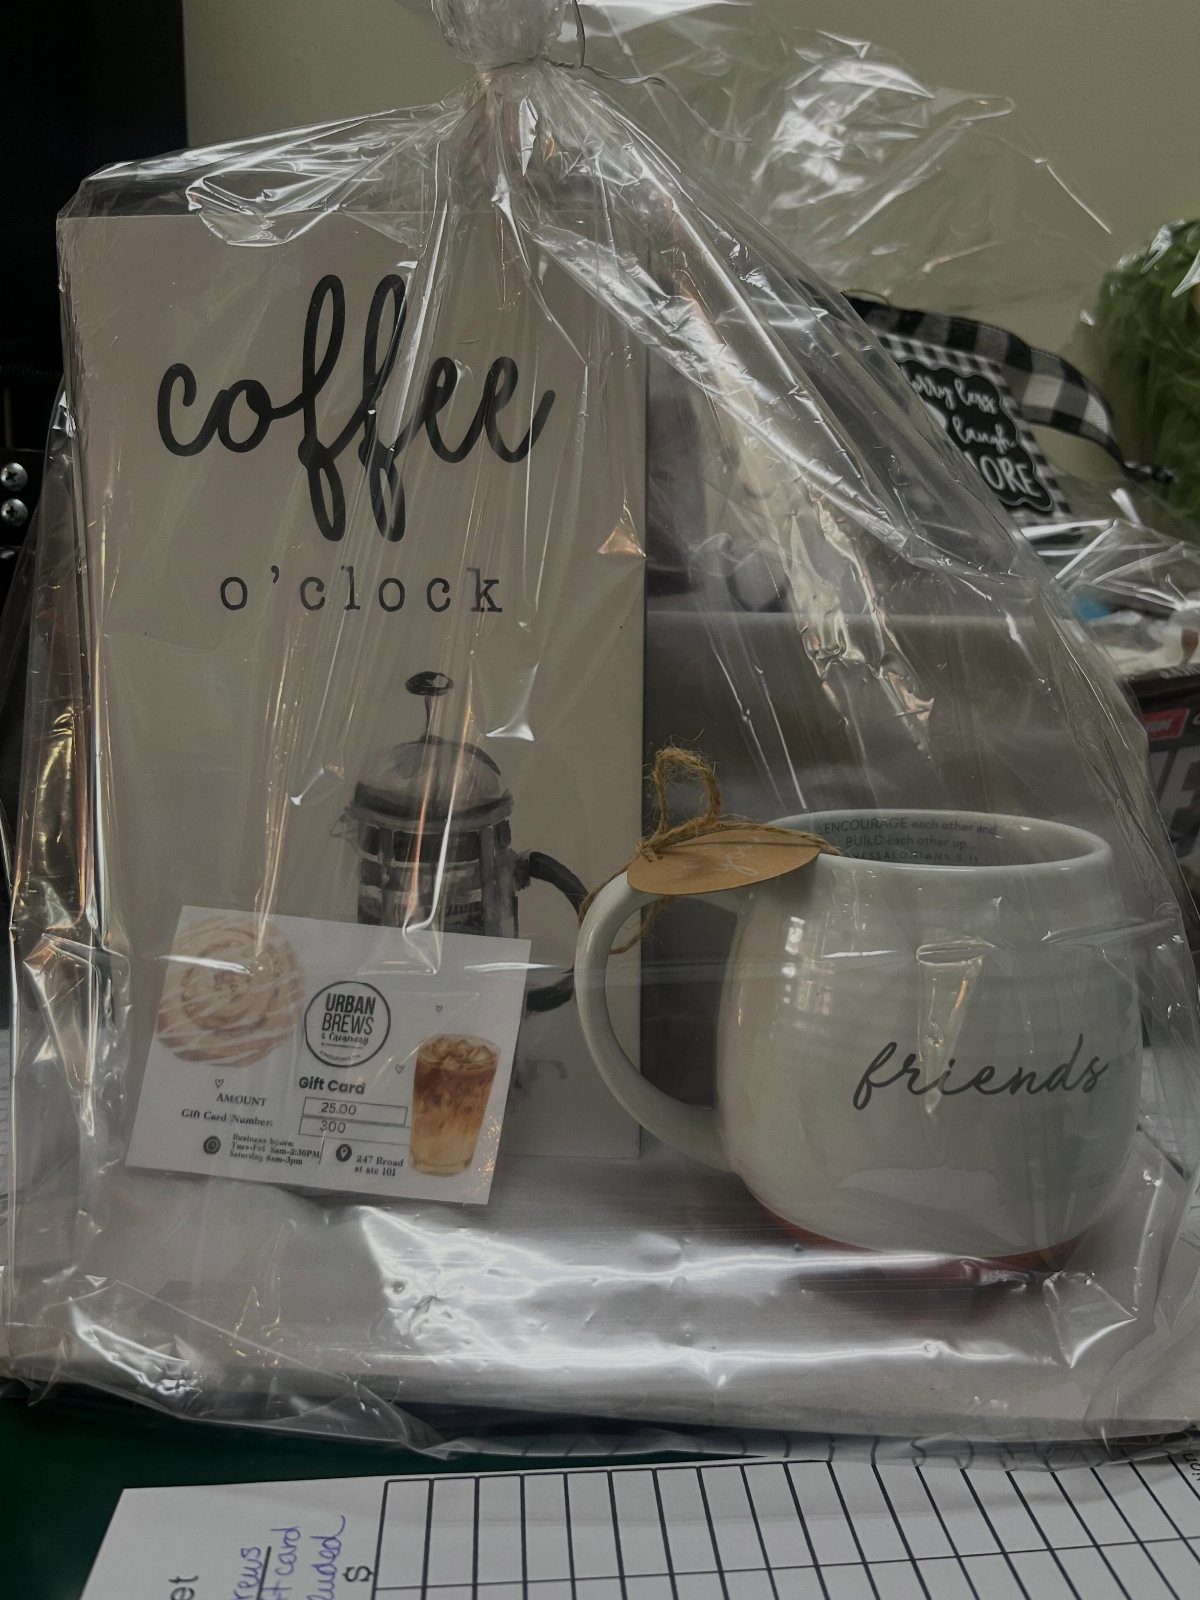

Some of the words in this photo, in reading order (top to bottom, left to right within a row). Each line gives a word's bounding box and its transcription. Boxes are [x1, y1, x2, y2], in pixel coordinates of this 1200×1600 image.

[157, 274, 556, 542] coffee
[974, 453, 1043, 498] ORE
[219, 565, 503, 612] o'clock
[824, 817, 909, 834] ENCOURAGE
[911, 819, 939, 830] each
[941, 821, 975, 832] other
[845, 834, 884, 849] BUILD
[886, 835, 914, 846] each
[917, 836, 950, 848] other
[325, 993, 377, 1016] URBAN
[321, 1012, 375, 1036] BREWS
[853, 1033, 1109, 1110] friends
[298, 1076, 325, 1091] Gift
[327, 1079, 366, 1095] Card
[216, 1093, 268, 1107] AMOUNT
[320, 1101, 357, 1116] 25.00
[181, 1108, 201, 1119] Gift
[203, 1110, 227, 1122] Card
[230, 1113, 274, 1127] Number:
[320, 1119, 346, 1134] 300
[232, 1133, 267, 1144] Business
[229, 1150, 263, 1163] Saturday
[375, 1156, 405, 1168] Broad
[270, 1525, 301, 1576] card
[342, 1565, 374, 1582] $
